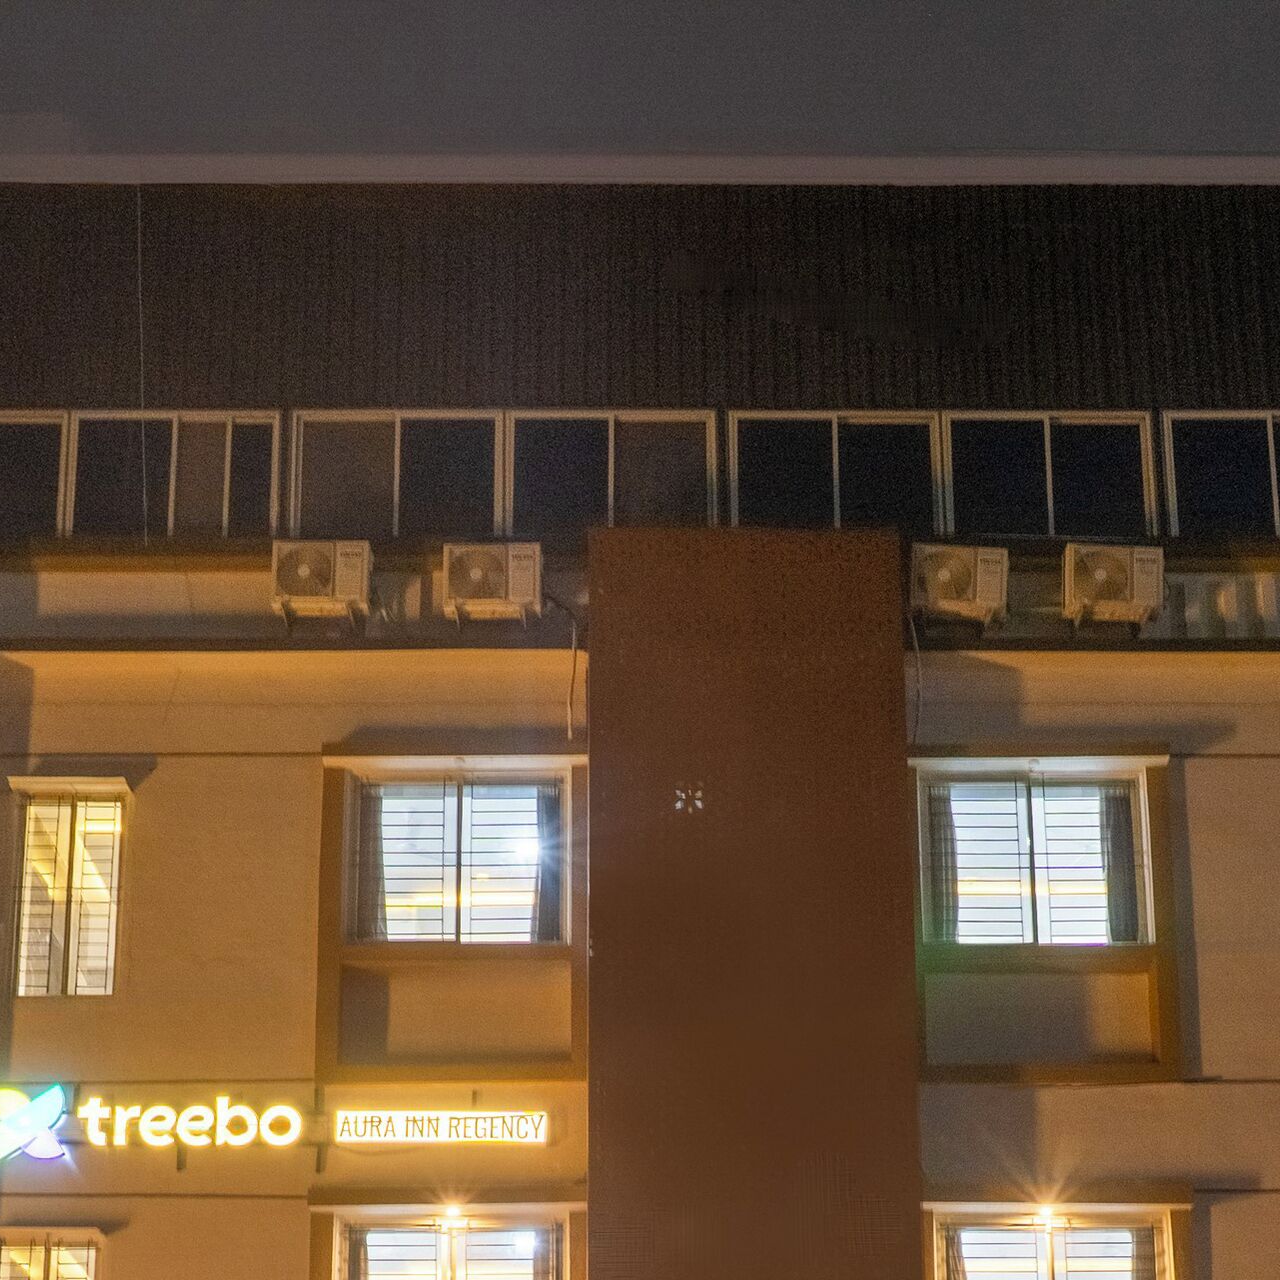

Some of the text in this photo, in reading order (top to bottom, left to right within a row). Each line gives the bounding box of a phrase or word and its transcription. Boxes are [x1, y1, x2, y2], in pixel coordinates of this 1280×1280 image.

[77, 1095, 303, 1147] treebo
[339, 1114, 545, 1140] AURA INN REGENCY
